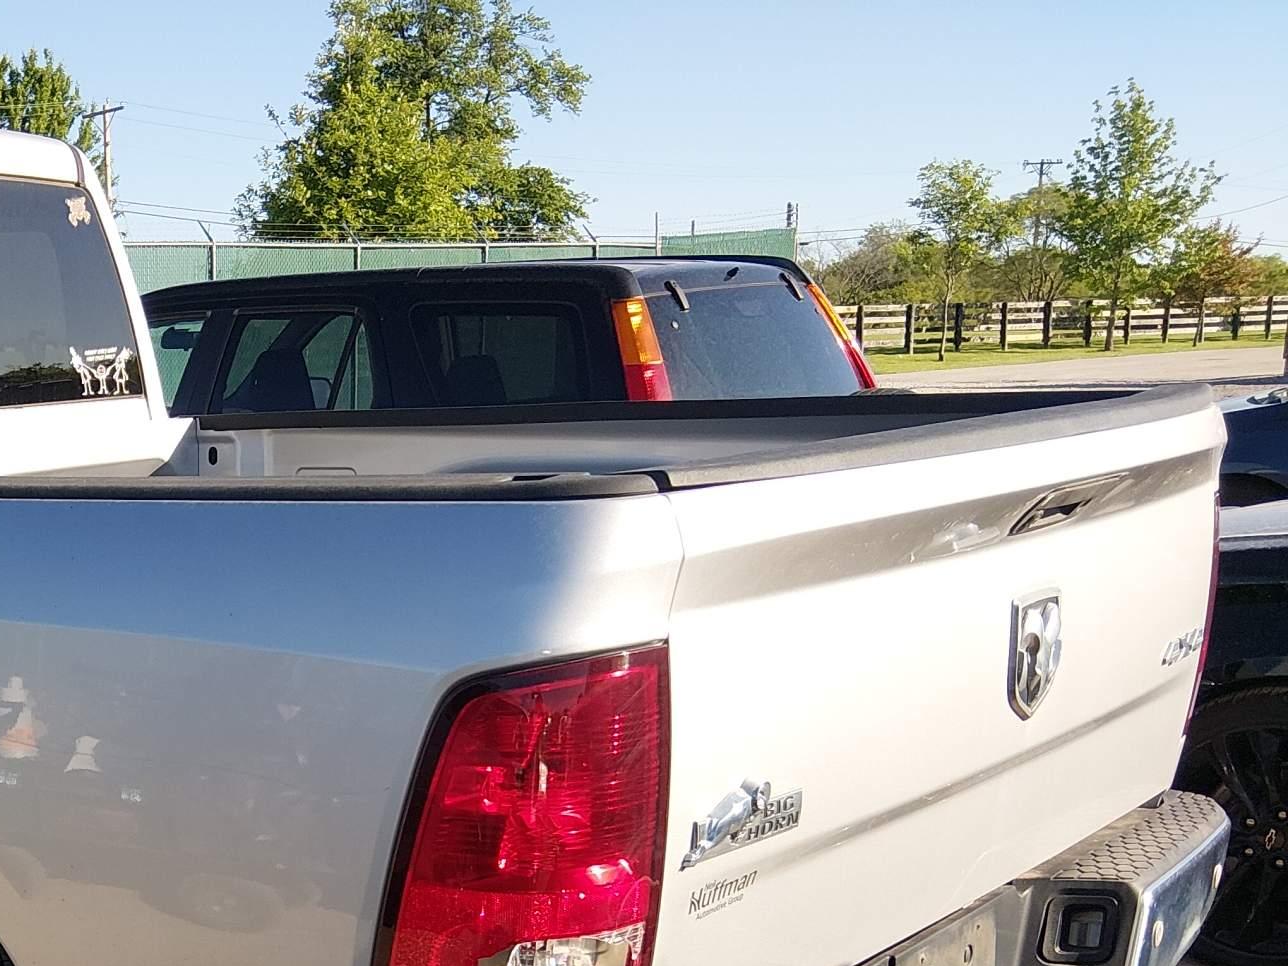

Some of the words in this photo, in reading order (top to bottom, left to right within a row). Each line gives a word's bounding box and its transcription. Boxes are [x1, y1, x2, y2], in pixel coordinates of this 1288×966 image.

[763, 796, 794, 817] BIG
[746, 811, 799, 841] HORN
[688, 870, 758, 915] Huffman
